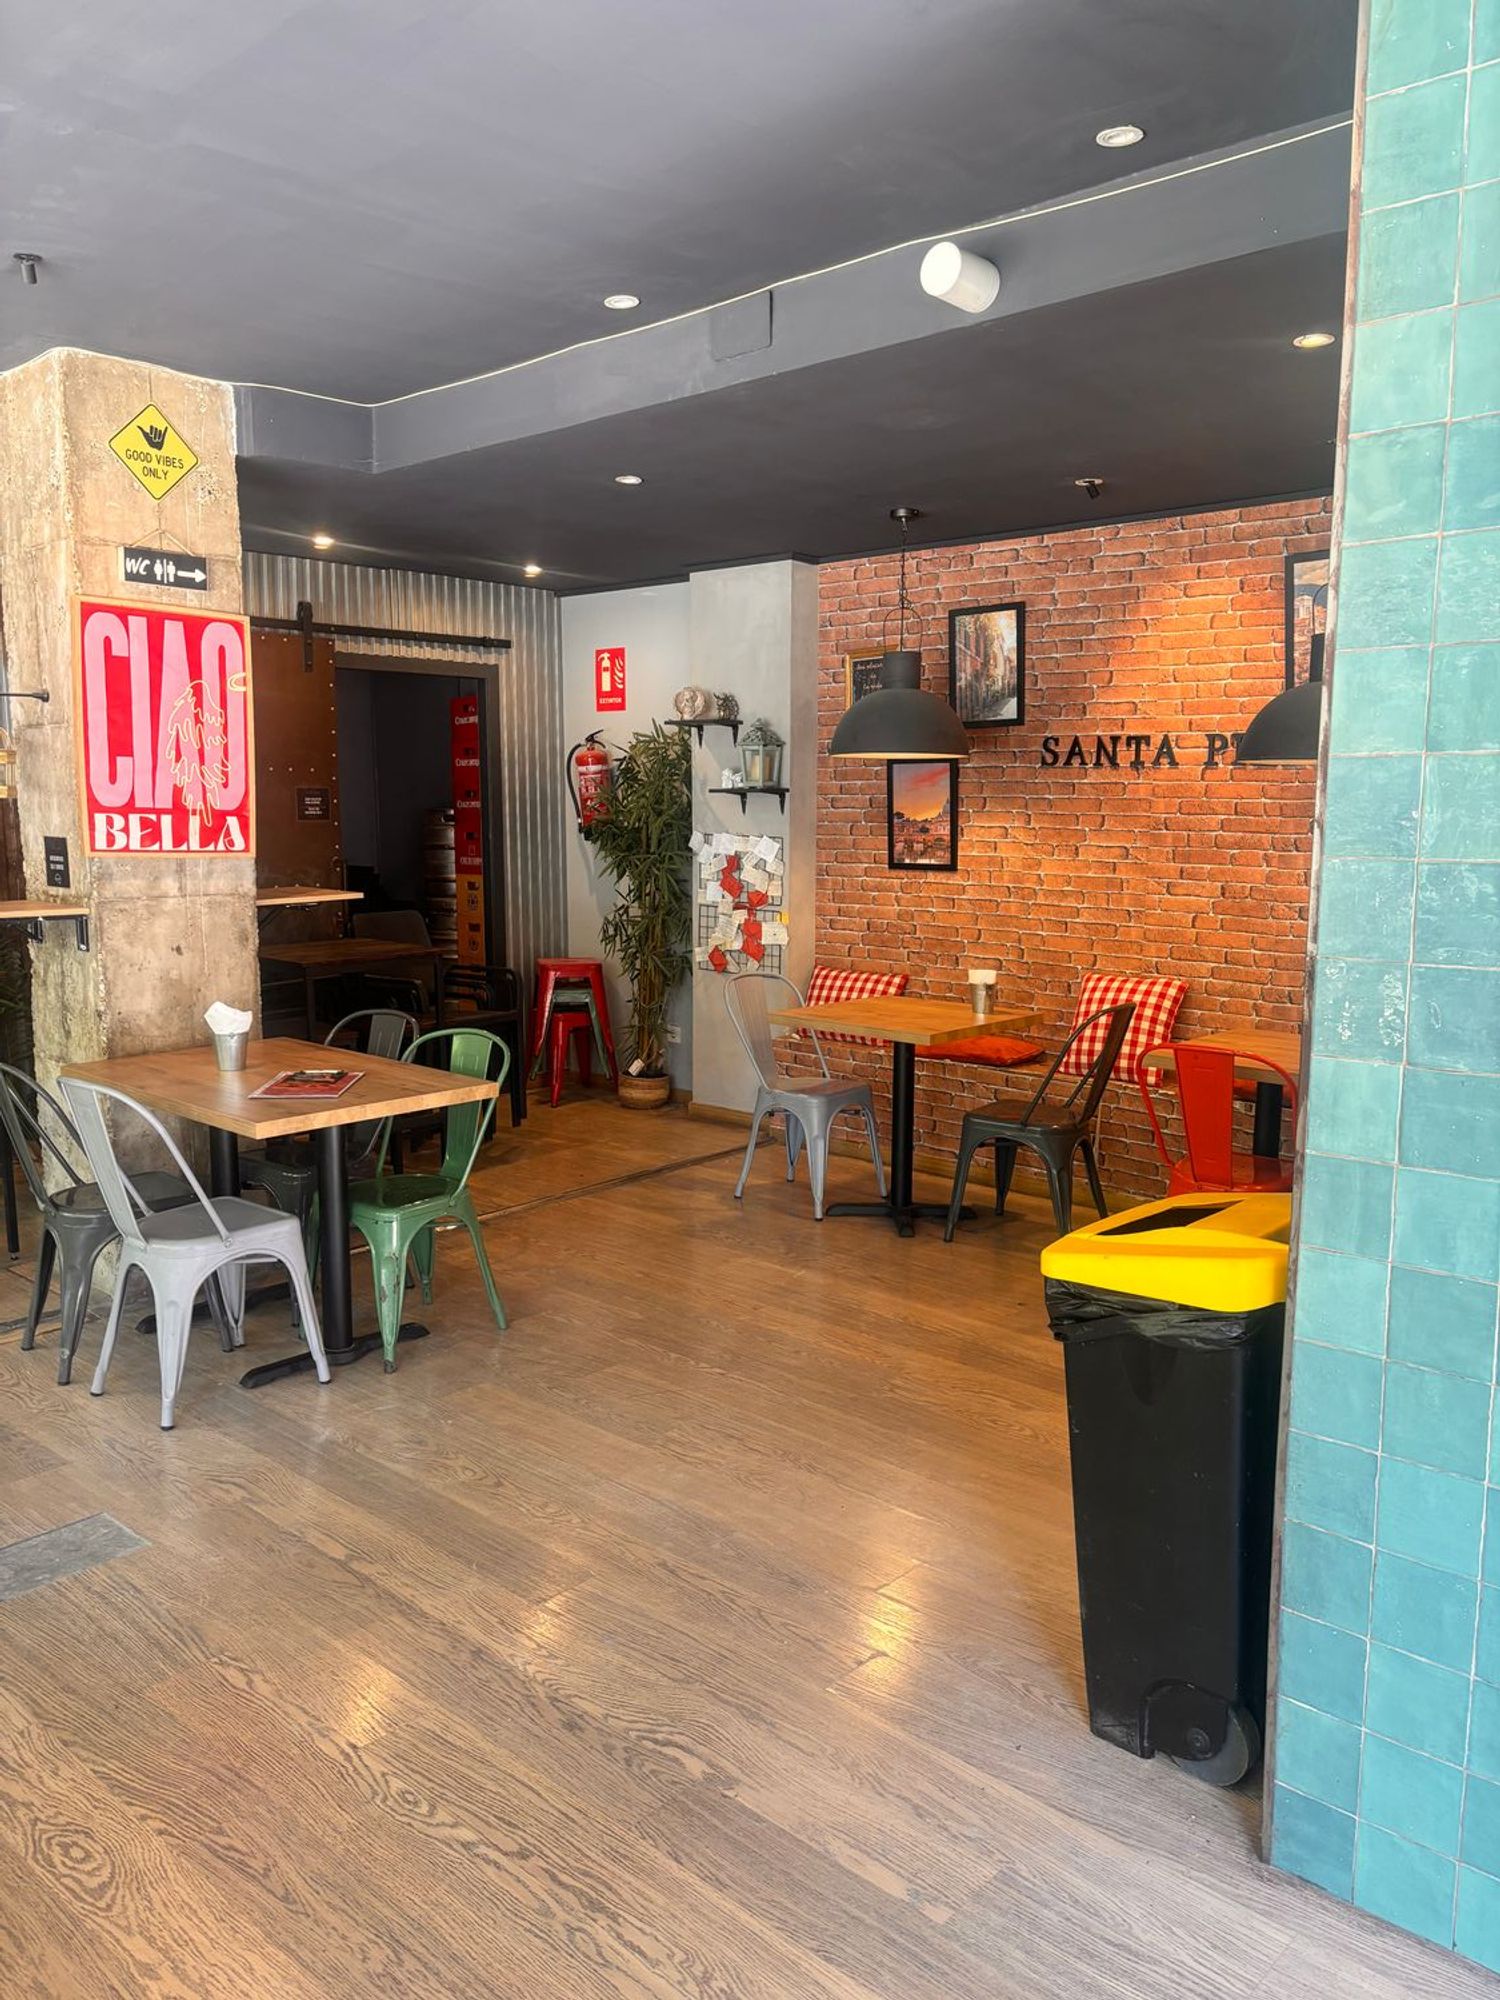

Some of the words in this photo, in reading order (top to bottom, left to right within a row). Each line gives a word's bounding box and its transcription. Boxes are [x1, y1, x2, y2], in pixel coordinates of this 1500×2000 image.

[125, 448, 153, 463] GOOD
[155, 454, 184, 469] VIBES
[142, 466, 169, 480] ONLY
[125, 556, 150, 575] WC
[84, 611, 247, 811] CIAO
[1041, 733, 1179, 769] SANTA
[94, 812, 246, 851] BELLA
